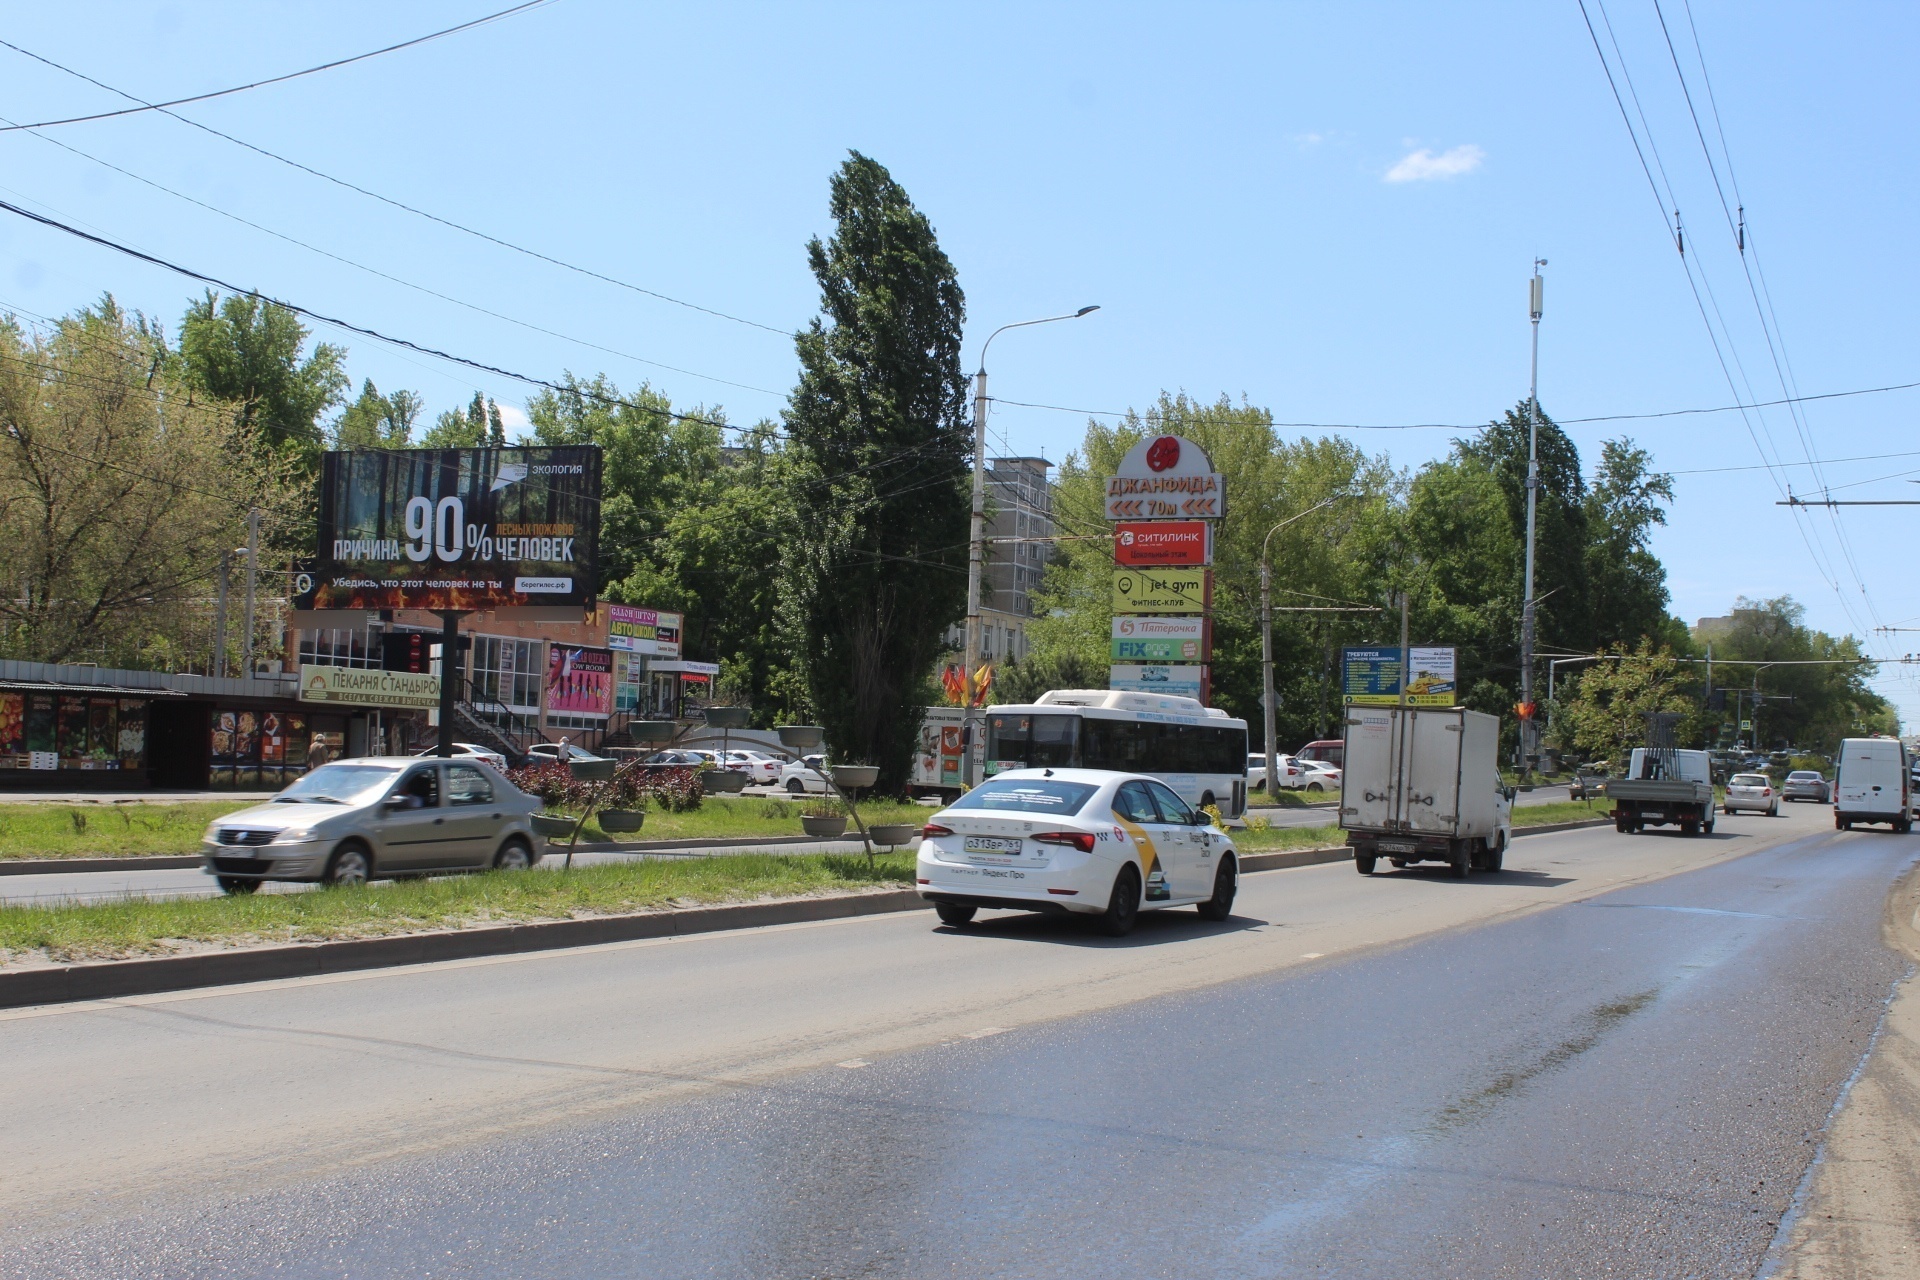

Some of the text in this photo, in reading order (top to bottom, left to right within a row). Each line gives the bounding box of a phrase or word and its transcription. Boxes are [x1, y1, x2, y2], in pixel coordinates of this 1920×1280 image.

[532, 465, 583, 475] ЭКОЛОГИЯ
[1108, 476, 1217, 497] ДЖАНФИДА
[1147, 500, 1177, 516] 70м
[496, 523, 575, 536] ЛЕСНЫХ ПОЖАРОВ
[1137, 532, 1200, 543] СИТИЛИНК
[333, 539, 400, 561] ПРИЧИНА
[495, 537, 575, 562] ЧЕЛОВЕК
[1130, 550, 1188, 560] Цокольный этаж
[332, 577, 503, 590] Убедись, что этот человек не ты
[520, 581, 566, 591] берегилес.рф
[1150, 579, 1200, 594] jet gym
[1131, 599, 1185, 607] ФИТНЕС-КЛУБ
[611, 607, 634, 618] САЛОН
[635, 611, 656, 621] ШТОР
[610, 621, 656, 640] АВТО ШКОЛА
[1137, 621, 1198, 635] Пятерочка
[1145, 643, 1171, 653] price
[333, 673, 379, 690] ПЕКАРНЯ
[381, 680, 387, 691] С
[338, 692, 367, 703] ВСЕГДА
[369, 694, 400, 705] СВЕЖАЯ
[402, 697, 436, 707] ВЫПЕЧКА
[986, 762, 999, 775] 49
[982, 868, 1008, 878] Яндекс
[1009, 870, 1025, 879] Про
